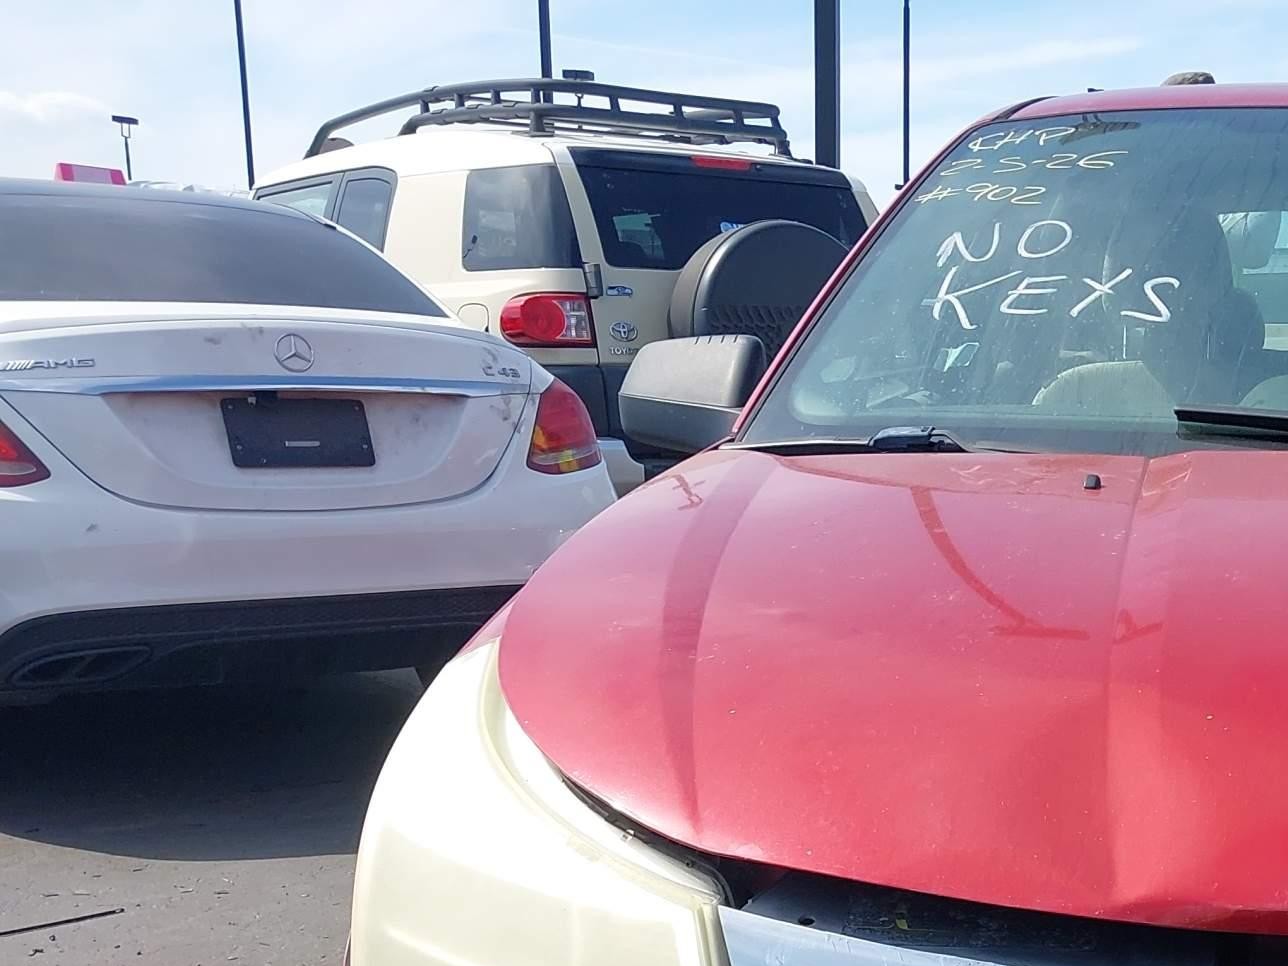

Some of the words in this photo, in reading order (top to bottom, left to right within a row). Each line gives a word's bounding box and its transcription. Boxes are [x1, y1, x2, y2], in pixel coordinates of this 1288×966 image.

[936, 219, 1073, 268] NO
[32, 358, 96, 369] AMG
[497, 367, 521, 378] 43
